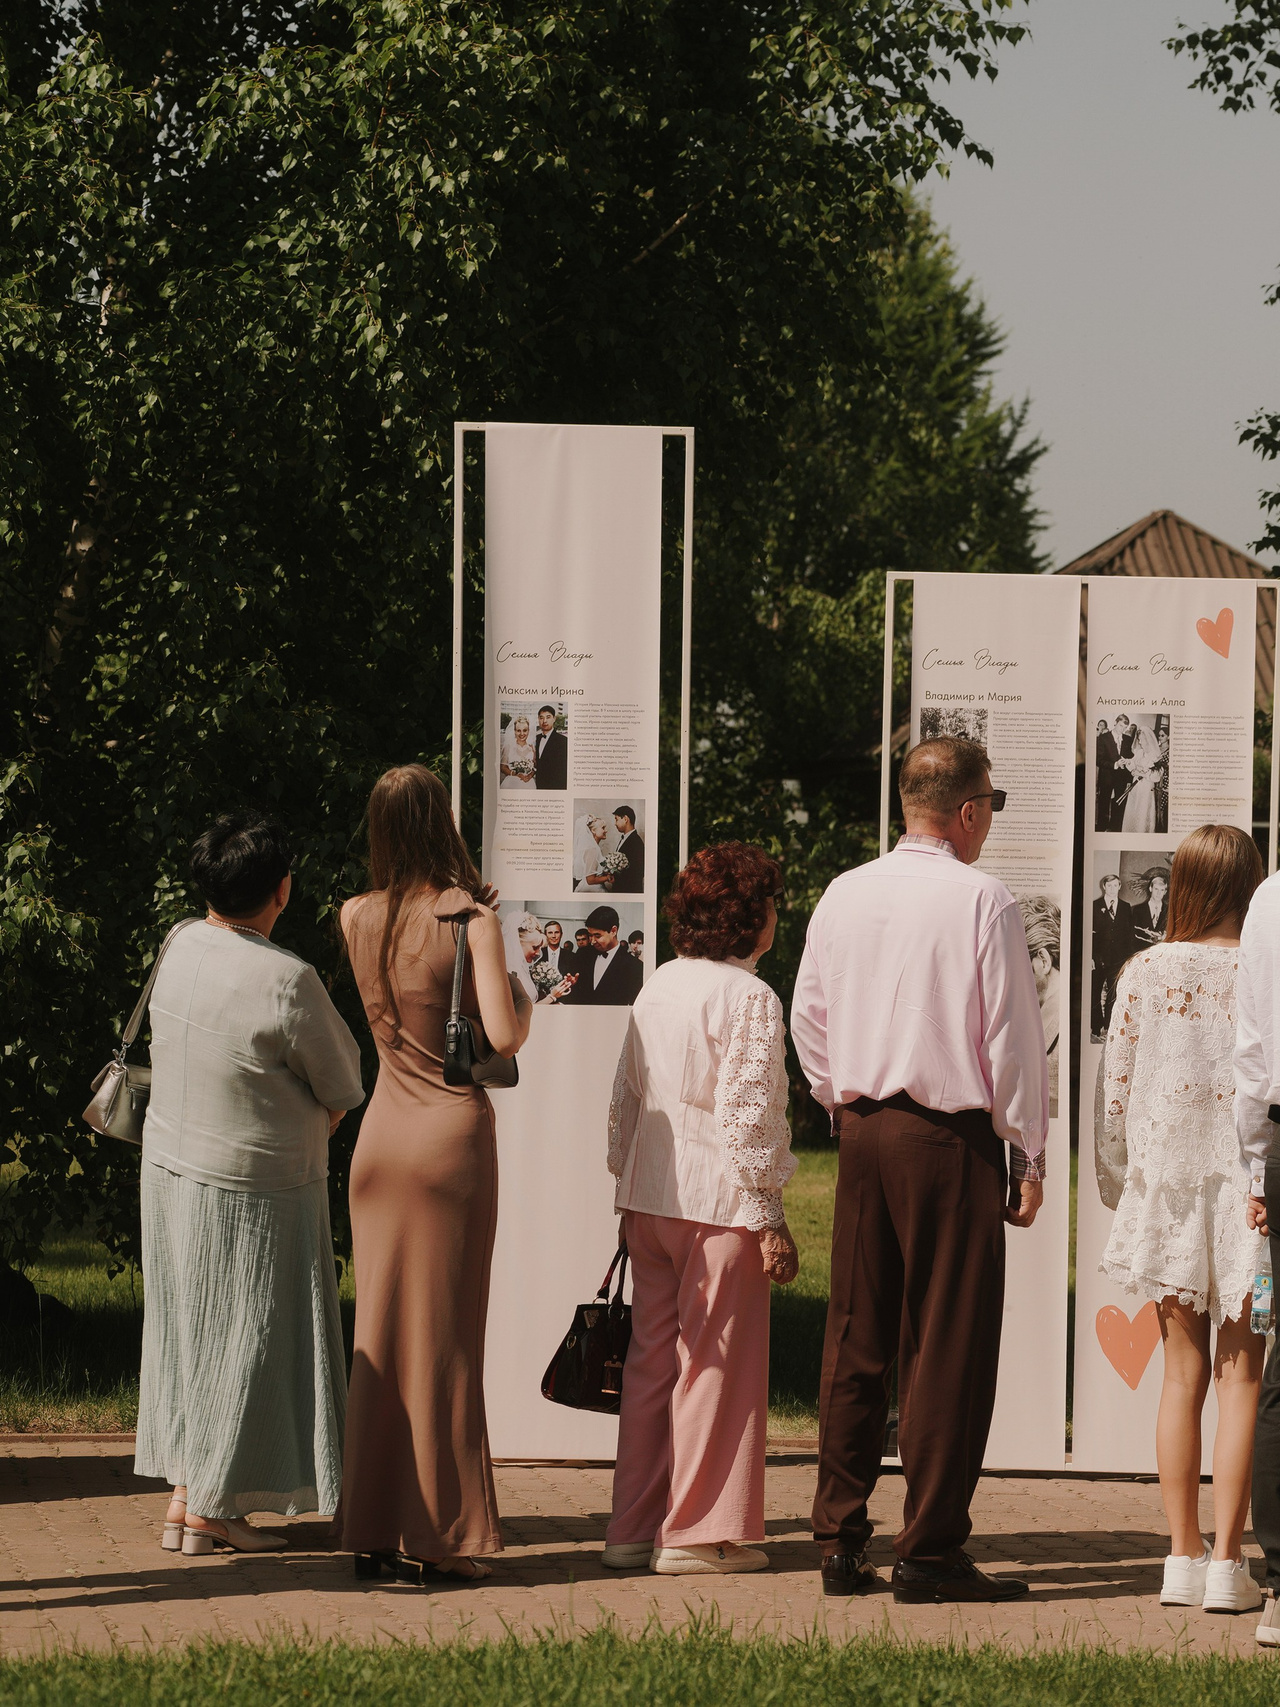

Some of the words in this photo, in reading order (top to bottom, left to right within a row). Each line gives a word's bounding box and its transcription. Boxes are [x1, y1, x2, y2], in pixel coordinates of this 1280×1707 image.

[496, 641, 539, 663] Семья
[549, 640, 593, 667] Влады
[922, 648, 965, 670] Семья
[974, 648, 1019, 675] Влады
[1097, 653, 1140, 675] Семья
[1149, 653, 1194, 680] Влады
[498, 686, 538, 695] Максим
[551, 686, 584, 697] Ирина
[926, 691, 975, 703] Владимир
[988, 692, 1021, 704] Мария
[1097, 696, 1145, 706] Анатолий
[1160, 697, 1185, 706] Алла
